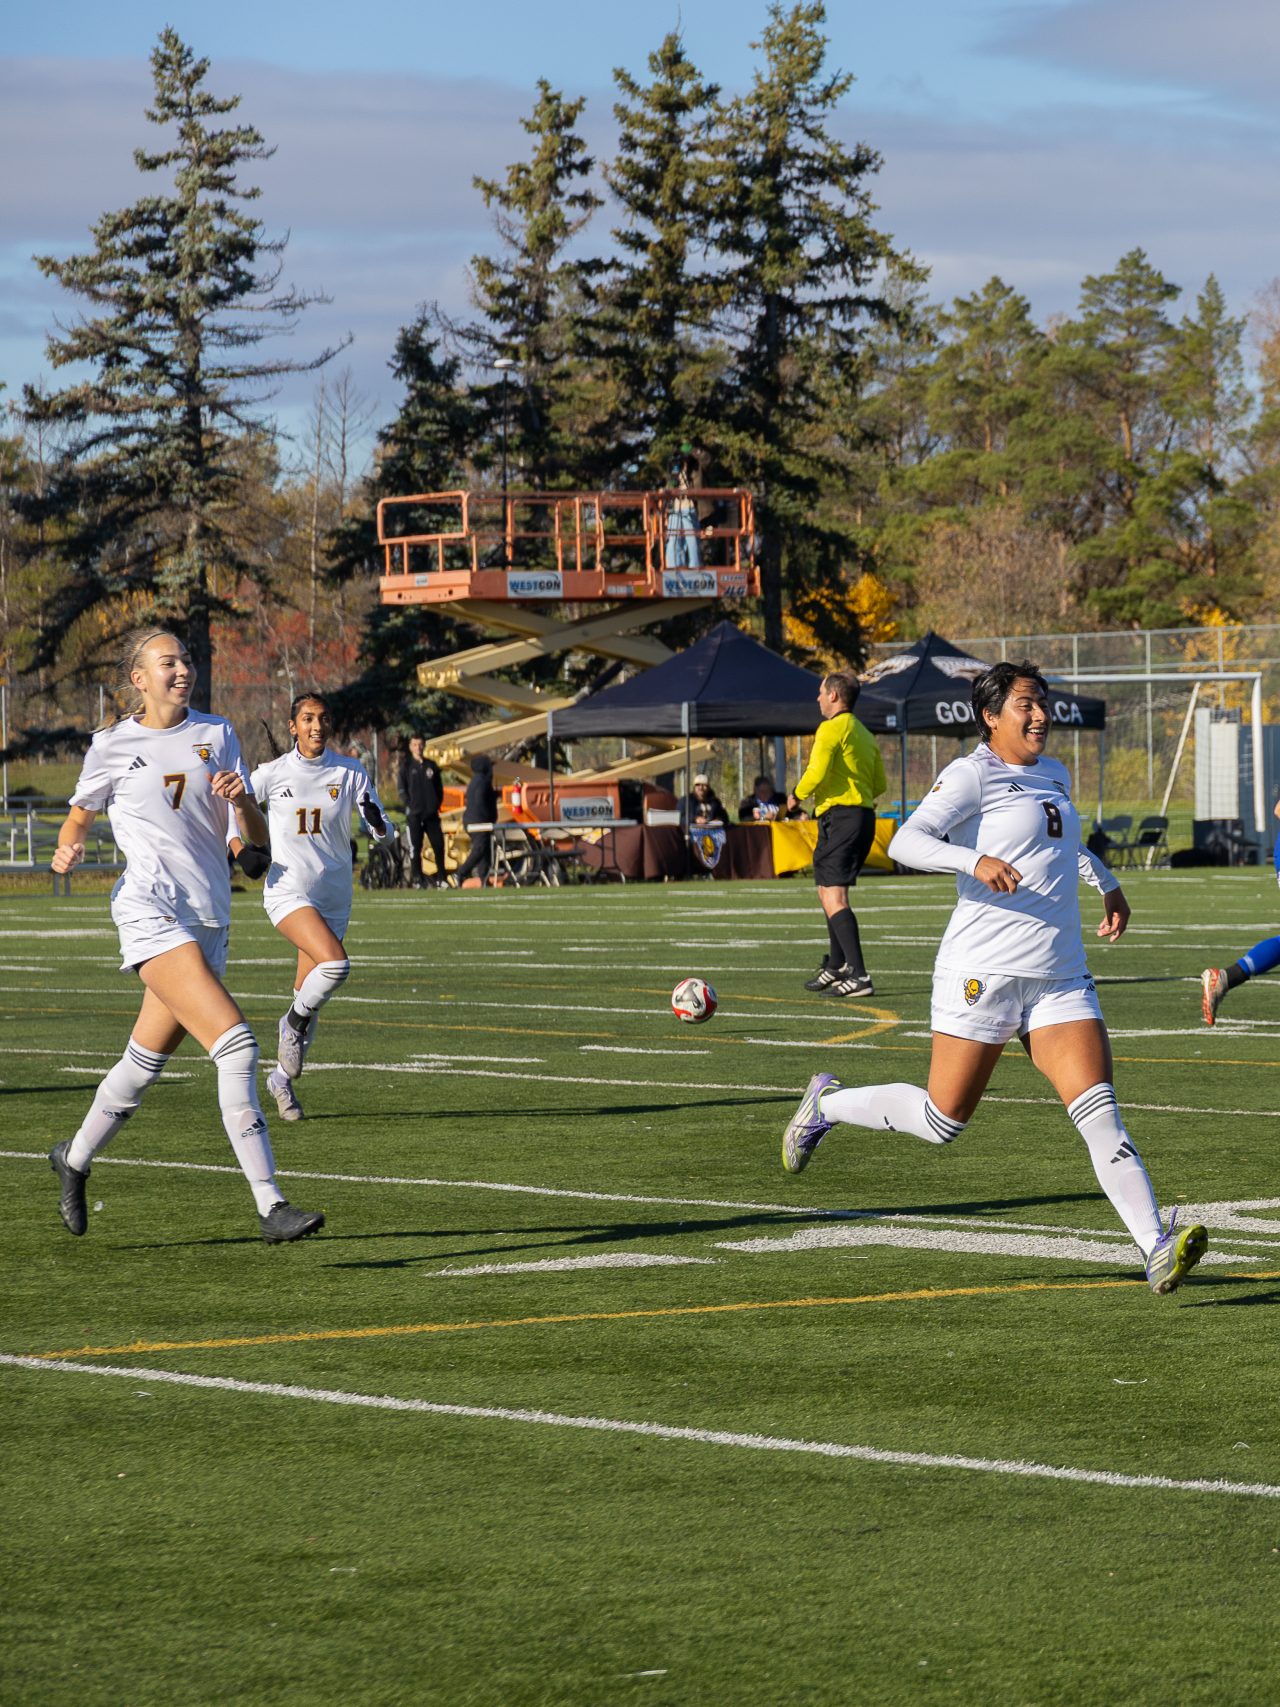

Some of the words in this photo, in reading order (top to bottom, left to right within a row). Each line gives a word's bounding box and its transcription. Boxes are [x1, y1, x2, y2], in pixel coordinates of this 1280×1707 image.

[509, 579, 561, 591] WESTCON
[163, 773, 187, 812] 7
[295, 808, 322, 835] 11
[562, 806, 613, 817] WESTCON
[1043, 801, 1063, 838] 8
